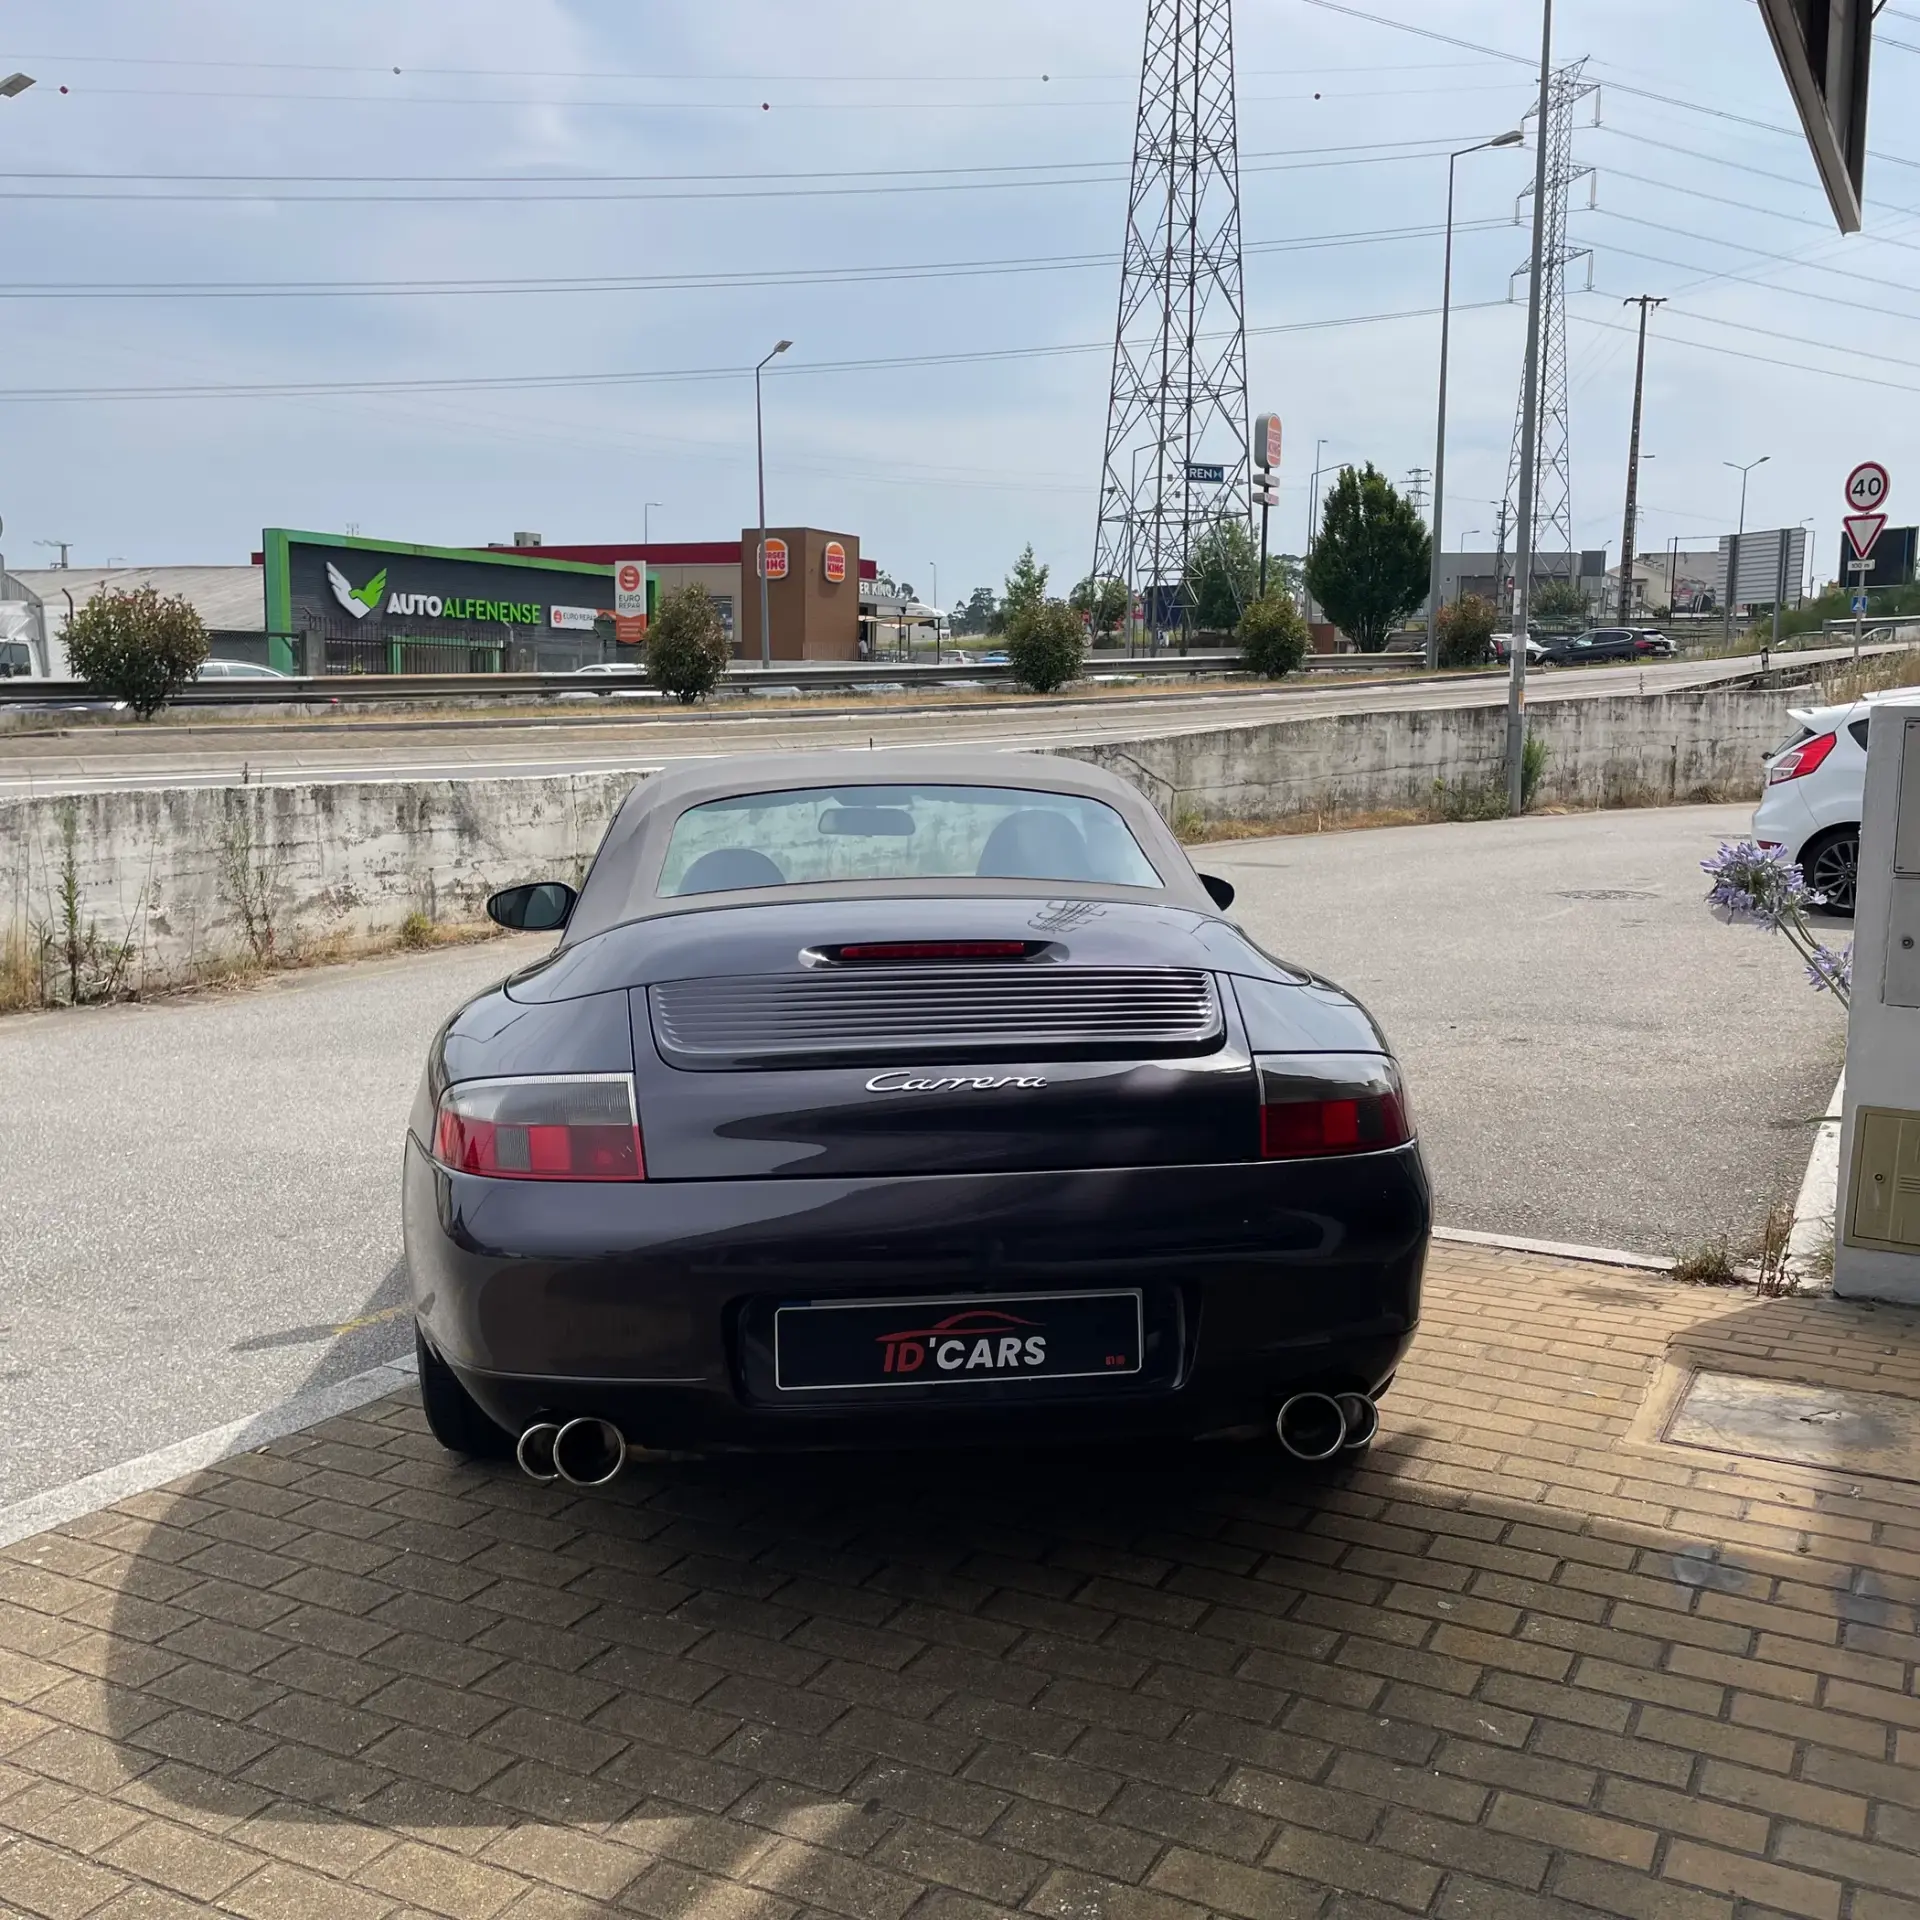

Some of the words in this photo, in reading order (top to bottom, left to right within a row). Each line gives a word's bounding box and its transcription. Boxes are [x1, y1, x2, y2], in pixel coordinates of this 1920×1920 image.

[1188, 467, 1213, 479] REN
[1851, 477, 1882, 497] 40
[827, 562, 845, 575] KING
[618, 594, 641, 602] EURO
[563, 612, 579, 621] EURO
[865, 1071, 1048, 1092] Carrera
